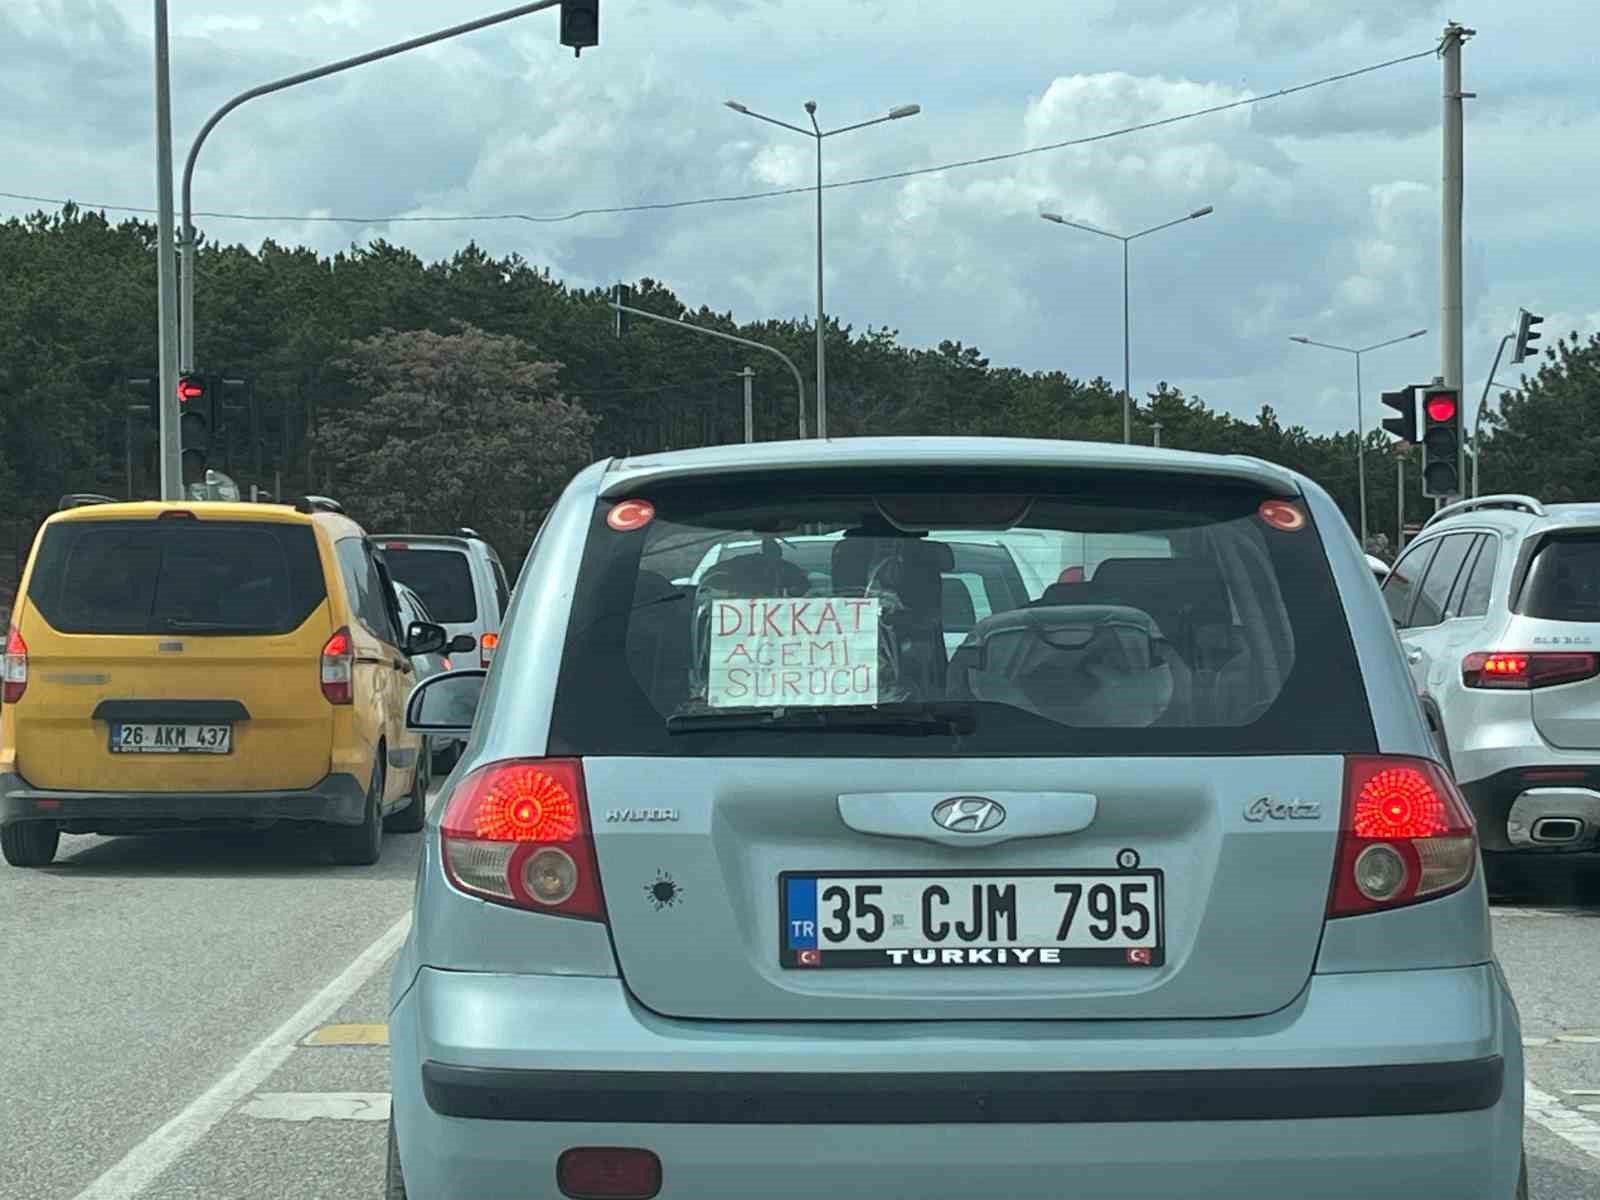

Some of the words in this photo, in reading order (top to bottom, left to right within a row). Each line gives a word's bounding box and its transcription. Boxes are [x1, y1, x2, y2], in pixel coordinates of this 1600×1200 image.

[718, 599, 871, 637] DİKKAT
[122, 727, 144, 745] 26
[154, 727, 186, 745] AKM
[197, 727, 228, 746] 437
[606, 808, 680, 823] HYUNDAI
[822, 885, 885, 943] 35
[921, 883, 1017, 942] CJM
[1053, 882, 1150, 942] 795
[791, 920, 815, 937] TR
